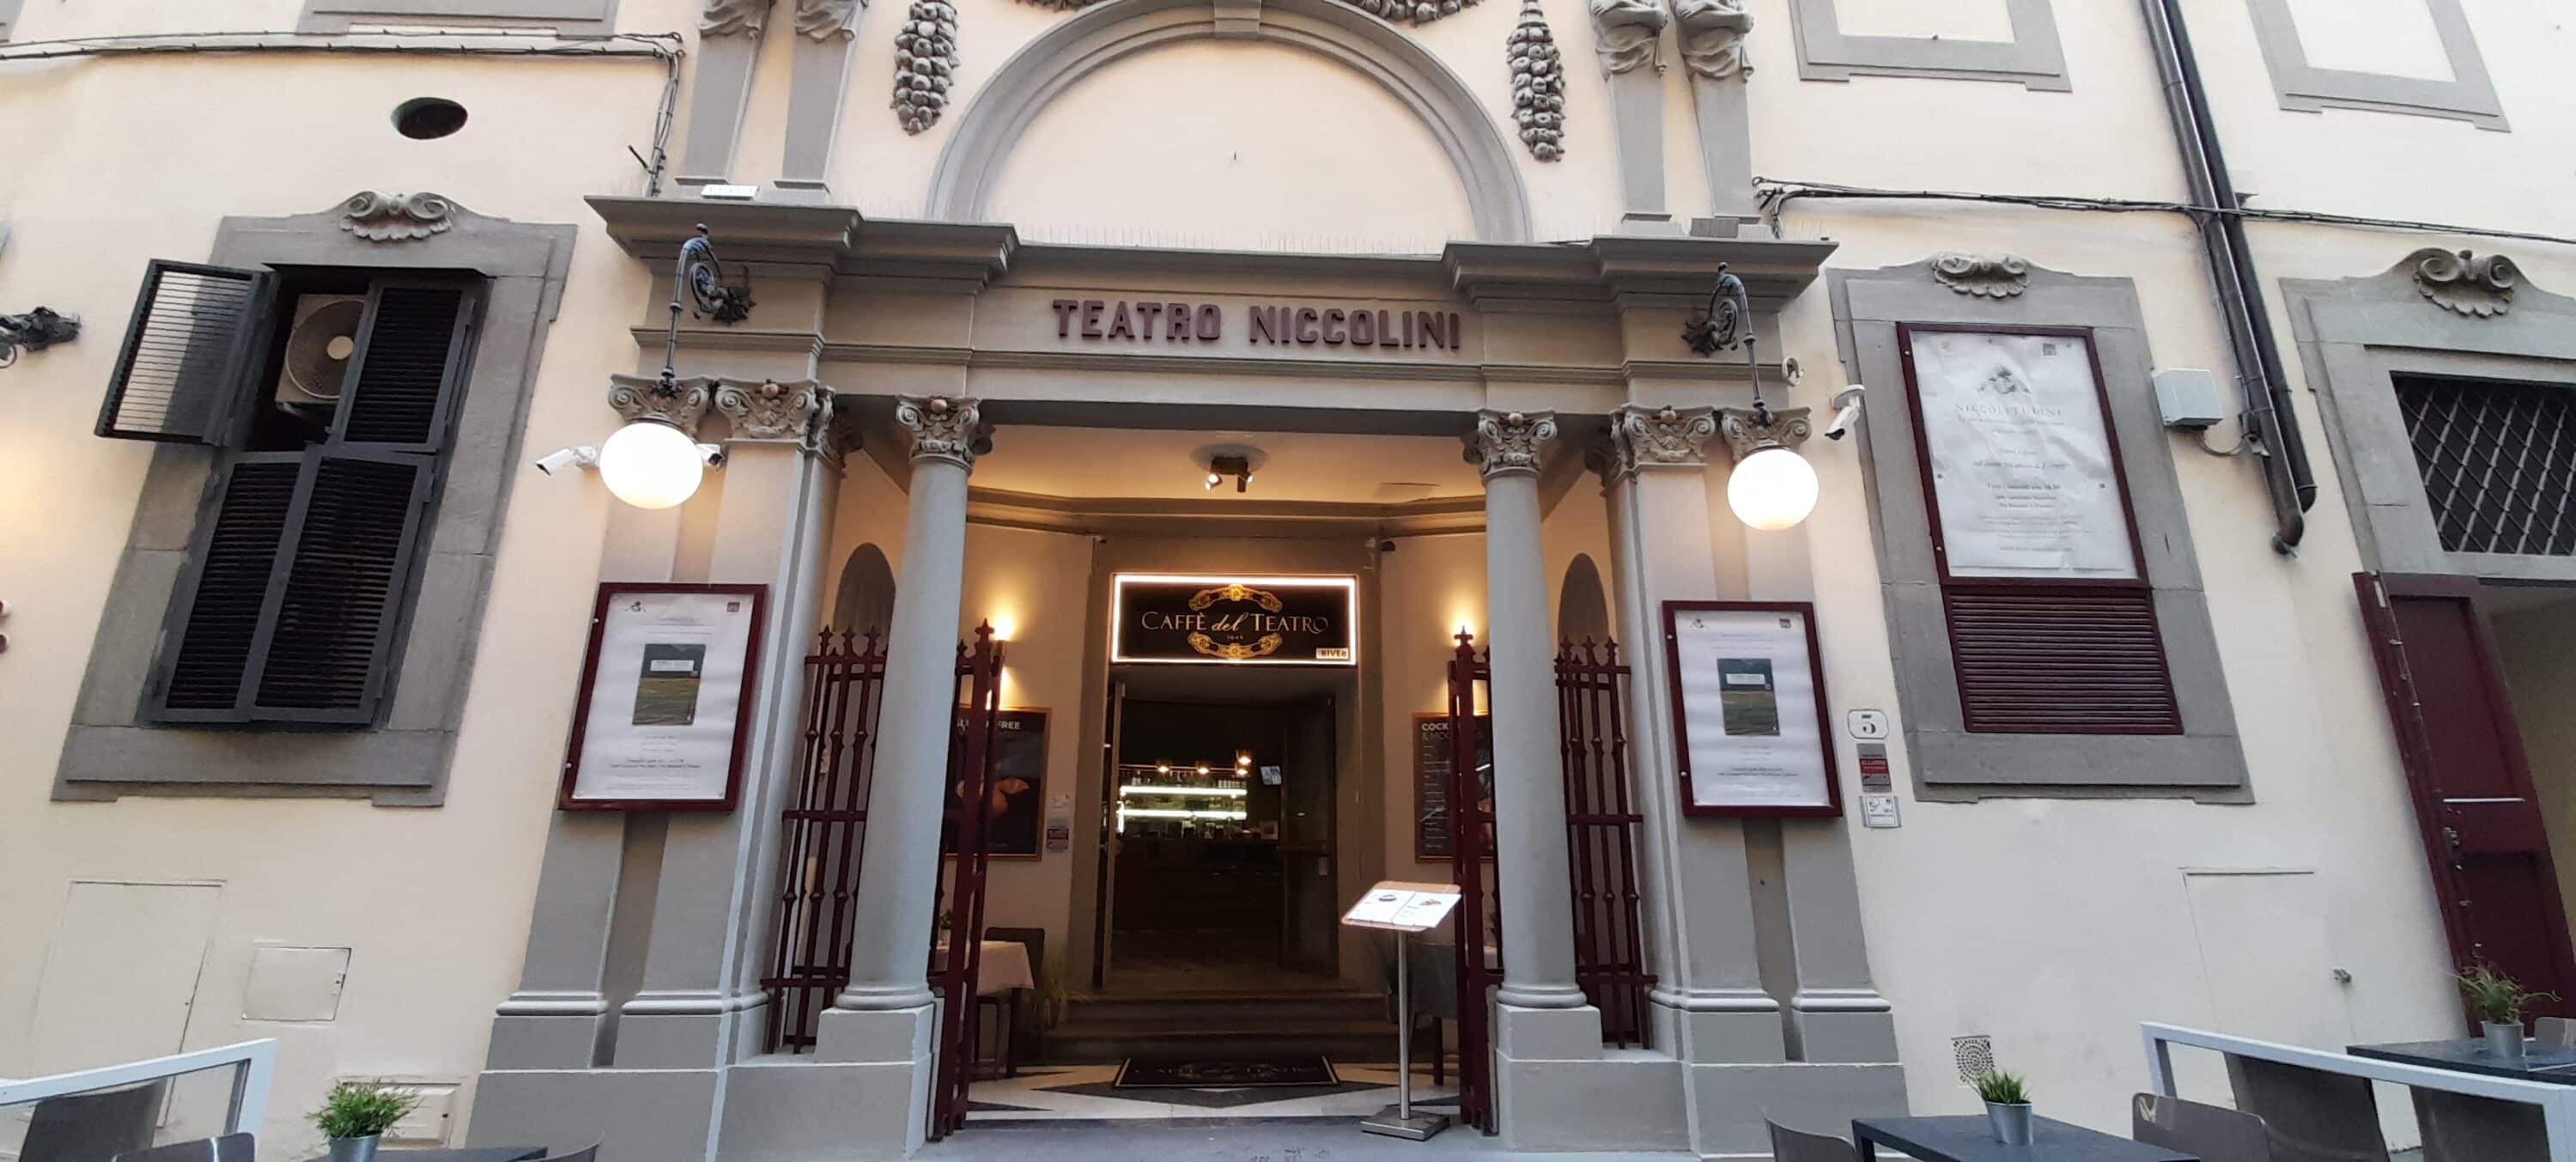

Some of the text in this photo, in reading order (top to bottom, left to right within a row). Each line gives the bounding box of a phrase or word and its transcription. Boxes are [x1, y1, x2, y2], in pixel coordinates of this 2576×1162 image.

[1053, 300, 1460, 350] TEATRO NICCOLINI
[1141, 611, 1328, 635] CAFFÈ del TEATRO
[1421, 721, 1449, 732] COCK
[1861, 714, 1876, 735] 5
